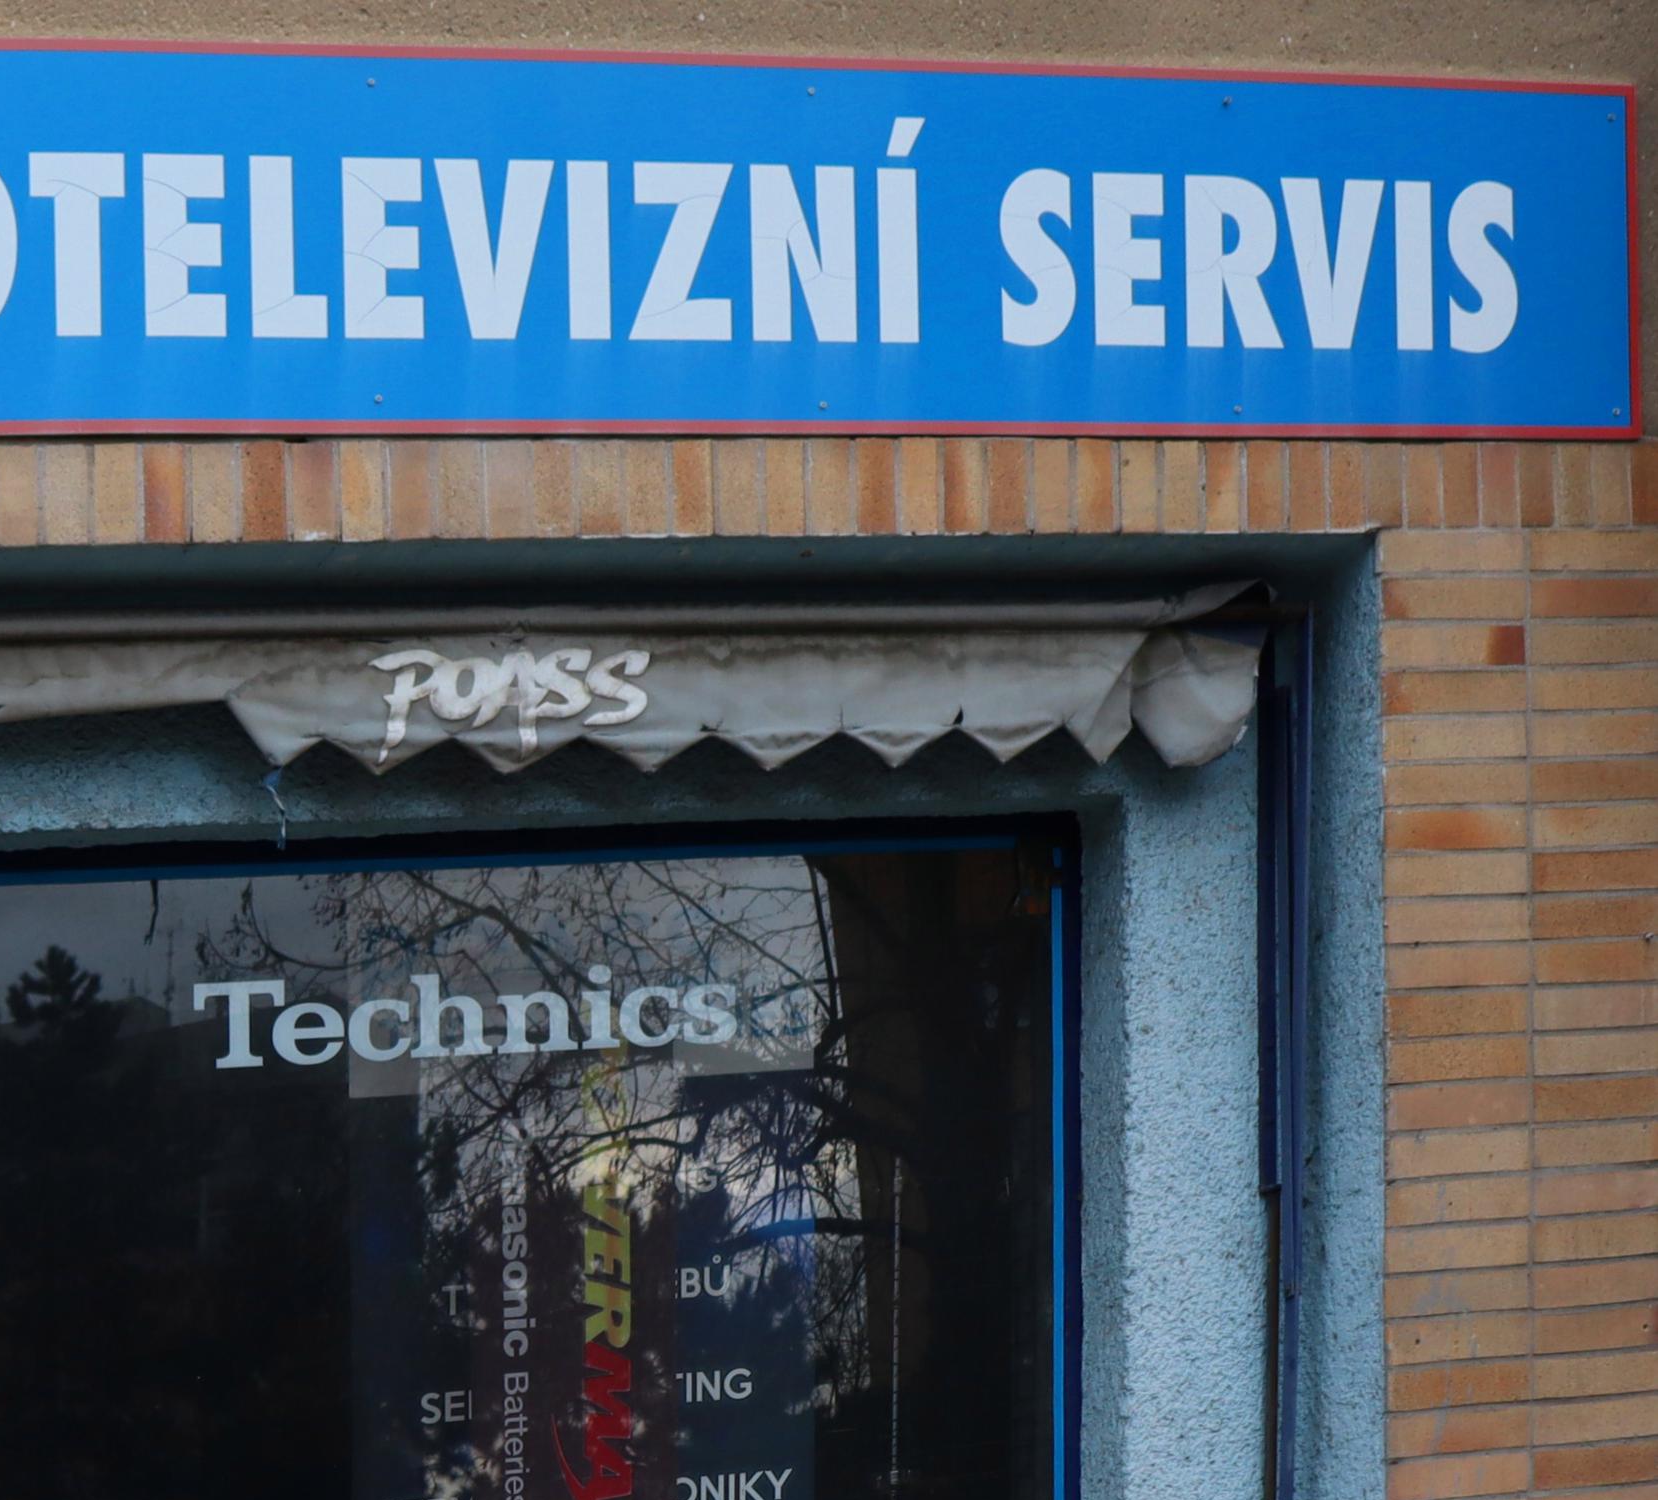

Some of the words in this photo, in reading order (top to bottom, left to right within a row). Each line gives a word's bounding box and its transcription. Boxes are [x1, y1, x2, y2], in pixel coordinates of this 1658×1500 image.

[999, 168, 1518, 353] SERVIS
[367, 647, 650, 764] POASS
[193, 964, 736, 1069] Technics
